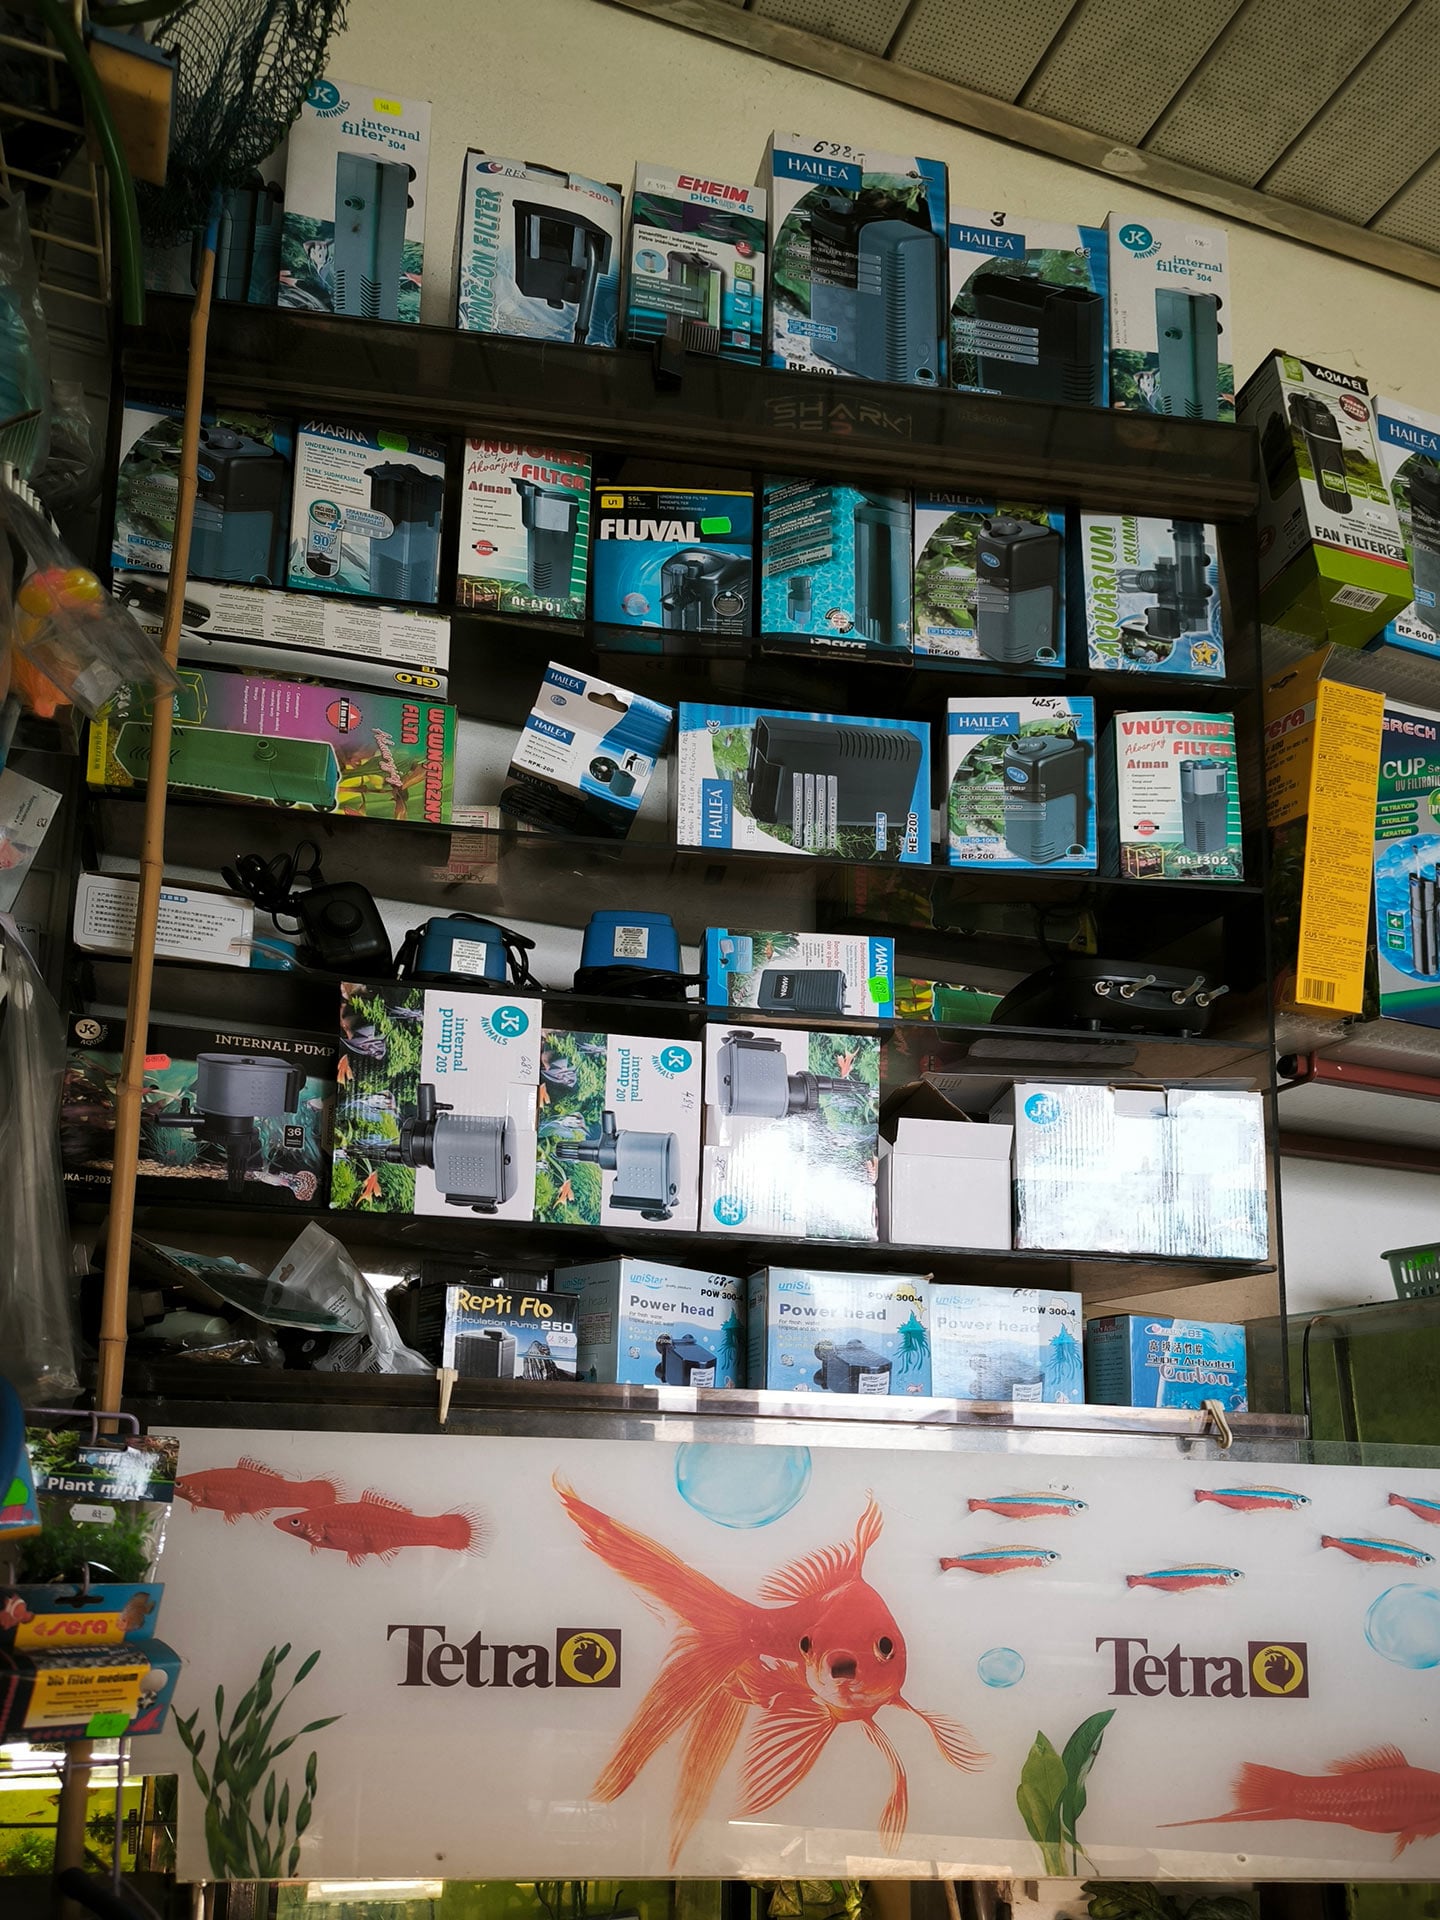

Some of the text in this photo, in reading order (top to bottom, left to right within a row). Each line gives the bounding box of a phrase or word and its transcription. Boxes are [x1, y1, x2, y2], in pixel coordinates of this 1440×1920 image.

[316, 99, 351, 119] ANIMALS
[341, 121, 406, 151] filter 304
[361, 118, 421, 142] internal
[504, 167, 527, 179] RES
[788, 157, 849, 181] HAILEA
[677, 174, 750, 203] EHEIM
[473, 187, 501, 249] FILTER
[738, 203, 754, 214] 45
[990, 211, 1007, 227] 3
[959, 230, 1014, 250] HAILEA
[1124, 230, 1146, 245] JK
[1133, 240, 1162, 259] ANIMALS
[1156, 259, 1212, 282] filter 304
[1173, 255, 1223, 273] internal
[788, 362, 835, 377] RP-600
[1315, 367, 1367, 393] AQUAEL
[303, 420, 369, 445] MARINA
[1389, 423, 1438, 451] HAILEA
[304, 440, 348, 456] UNDERWATER
[348, 450, 368, 460] FILTER
[521, 463, 587, 491] FILTER
[467, 480, 513, 496] Atman
[928, 491, 985, 506] HAILEA
[600, 518, 702, 544] FLUVAL
[1314, 525, 1341, 543] FAN
[1344, 533, 1387, 556] FILTER
[126, 557, 163, 571] RP-400
[1089, 525, 1122, 658] AQUARIUM
[1398, 624, 1434, 642] RP-600
[927, 648, 961, 657] RP-400
[394, 671, 441, 689] GLO
[550, 671, 580, 690] HAILEA
[401, 703, 420, 745] FILTR
[533, 720, 568, 739] HAILEA
[959, 716, 1010, 728] HAILEA
[1172, 741, 1233, 757] FILTER
[424, 707, 446, 825] WEWNĘTRZNY
[1126, 758, 1169, 770] Atman
[1382, 757, 1426, 779] CUP
[708, 789, 723, 840] HAILEA
[1381, 802, 1415, 812] FILTRATION
[907, 812, 919, 853] HE-200
[961, 852, 995, 861] RP-200
[875, 942, 889, 977] MARI
[79, 1023, 96, 1036] JK
[502, 1009, 521, 1031] JK
[480, 1015, 510, 1046] ANIMALS
[215, 1034, 336, 1058] INTERNAL PUMP
[436, 1007, 454, 1074] pump 203
[451, 1017, 468, 1073] internal
[651, 1055, 676, 1080] ANIMALS
[667, 1049, 685, 1068] JK
[615, 1047, 631, 1102] pump 201
[630, 1055, 644, 1102] internal
[287, 1127, 303, 1138] 36
[629, 1272, 664, 1290] uniStar
[700, 1288, 720, 1298] POW
[895, 1293, 924, 1303] 300-4
[935, 1295, 976, 1309] uniStar
[453, 1288, 555, 1319] Repti Flo
[629, 1294, 715, 1318] Power head
[779, 1302, 888, 1321] Power head
[1022, 1305, 1077, 1317] POW 300-4
[451, 1314, 573, 1333] Circulation Pump 250
[937, 1316, 1041, 1333] Power head
[1146, 1353, 1236, 1370] Super Activated
[1158, 1363, 1234, 1388] Carbon
[47, 1476, 95, 1494] Plant
[48, 1618, 109, 1637] sera
[386, 1624, 555, 1690] Tetra
[1095, 1636, 1252, 1701] Tetra
[47, 1672, 139, 1687] bio filter medium
